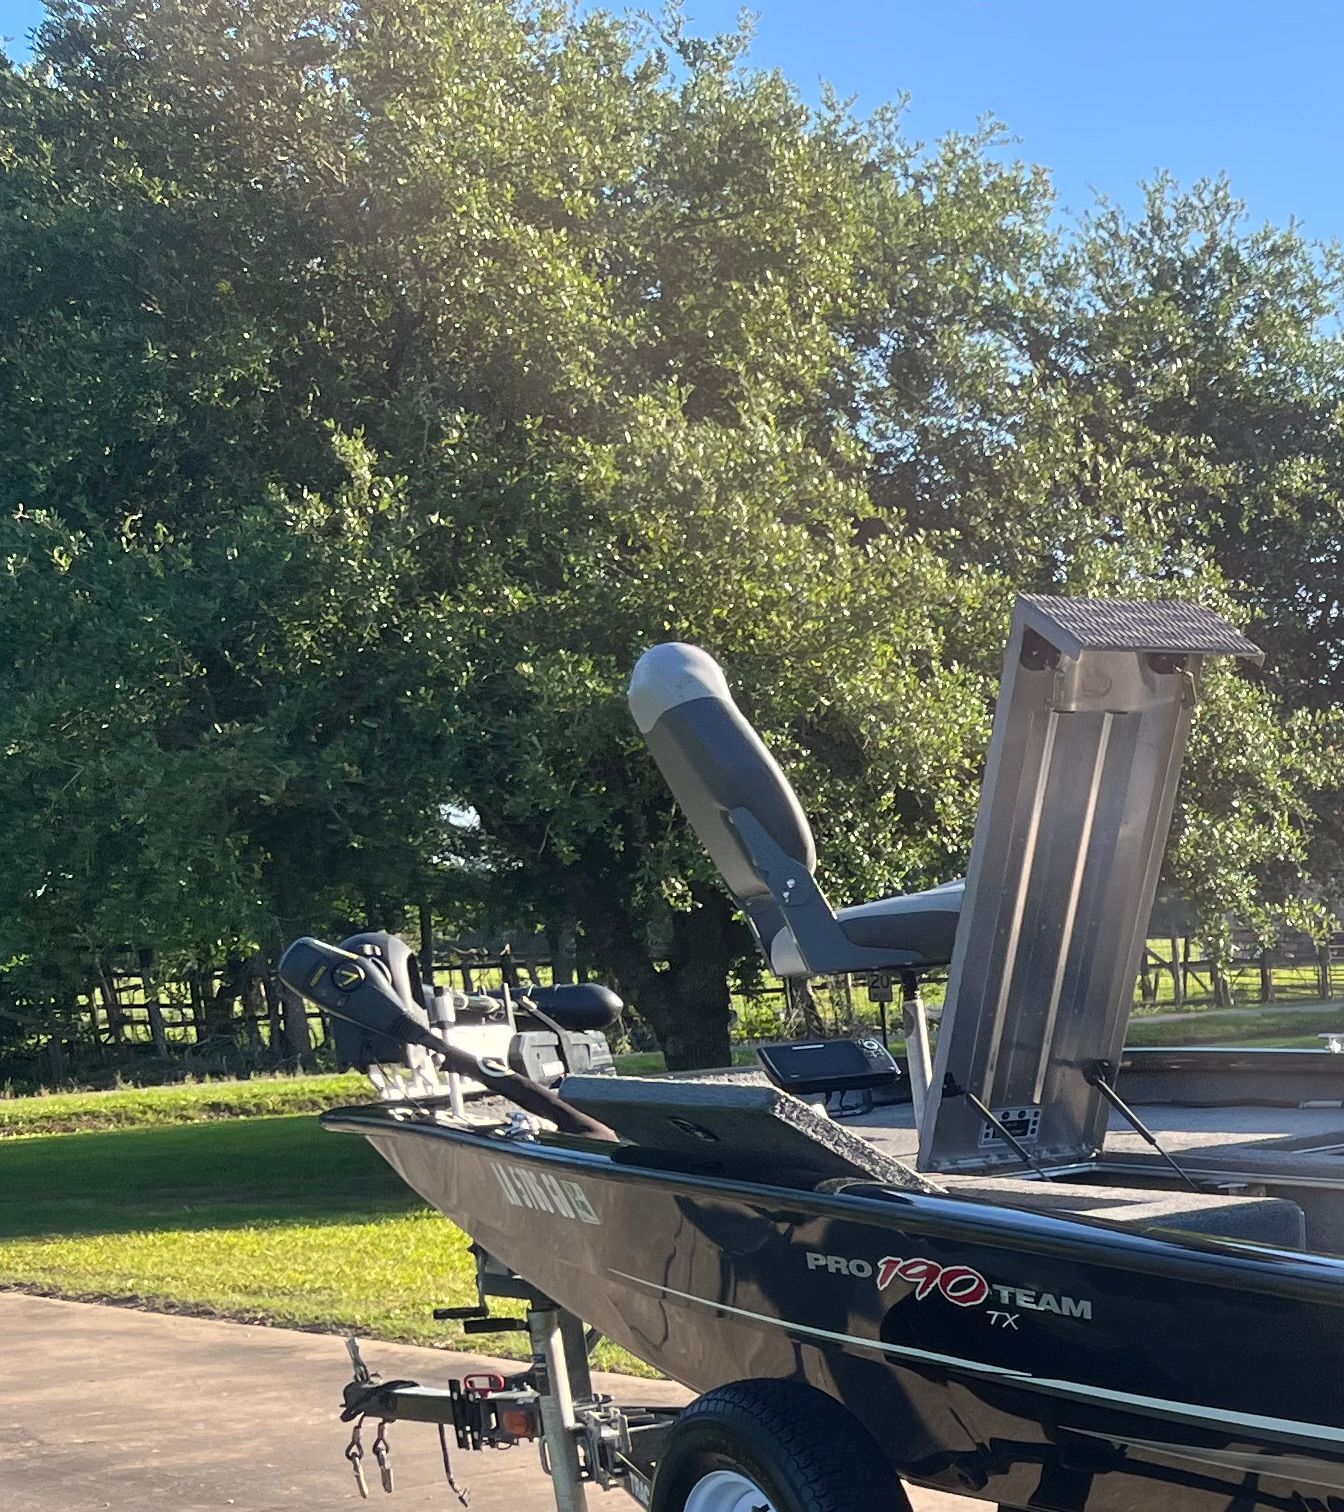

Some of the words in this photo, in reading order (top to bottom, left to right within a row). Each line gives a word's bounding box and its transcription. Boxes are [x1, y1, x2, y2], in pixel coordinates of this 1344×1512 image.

[806, 1252, 873, 1278] PRO
[877, 1256, 989, 1306] 190
[991, 1284, 1092, 1320] TEAM
[986, 1310, 1020, 1330] TX
